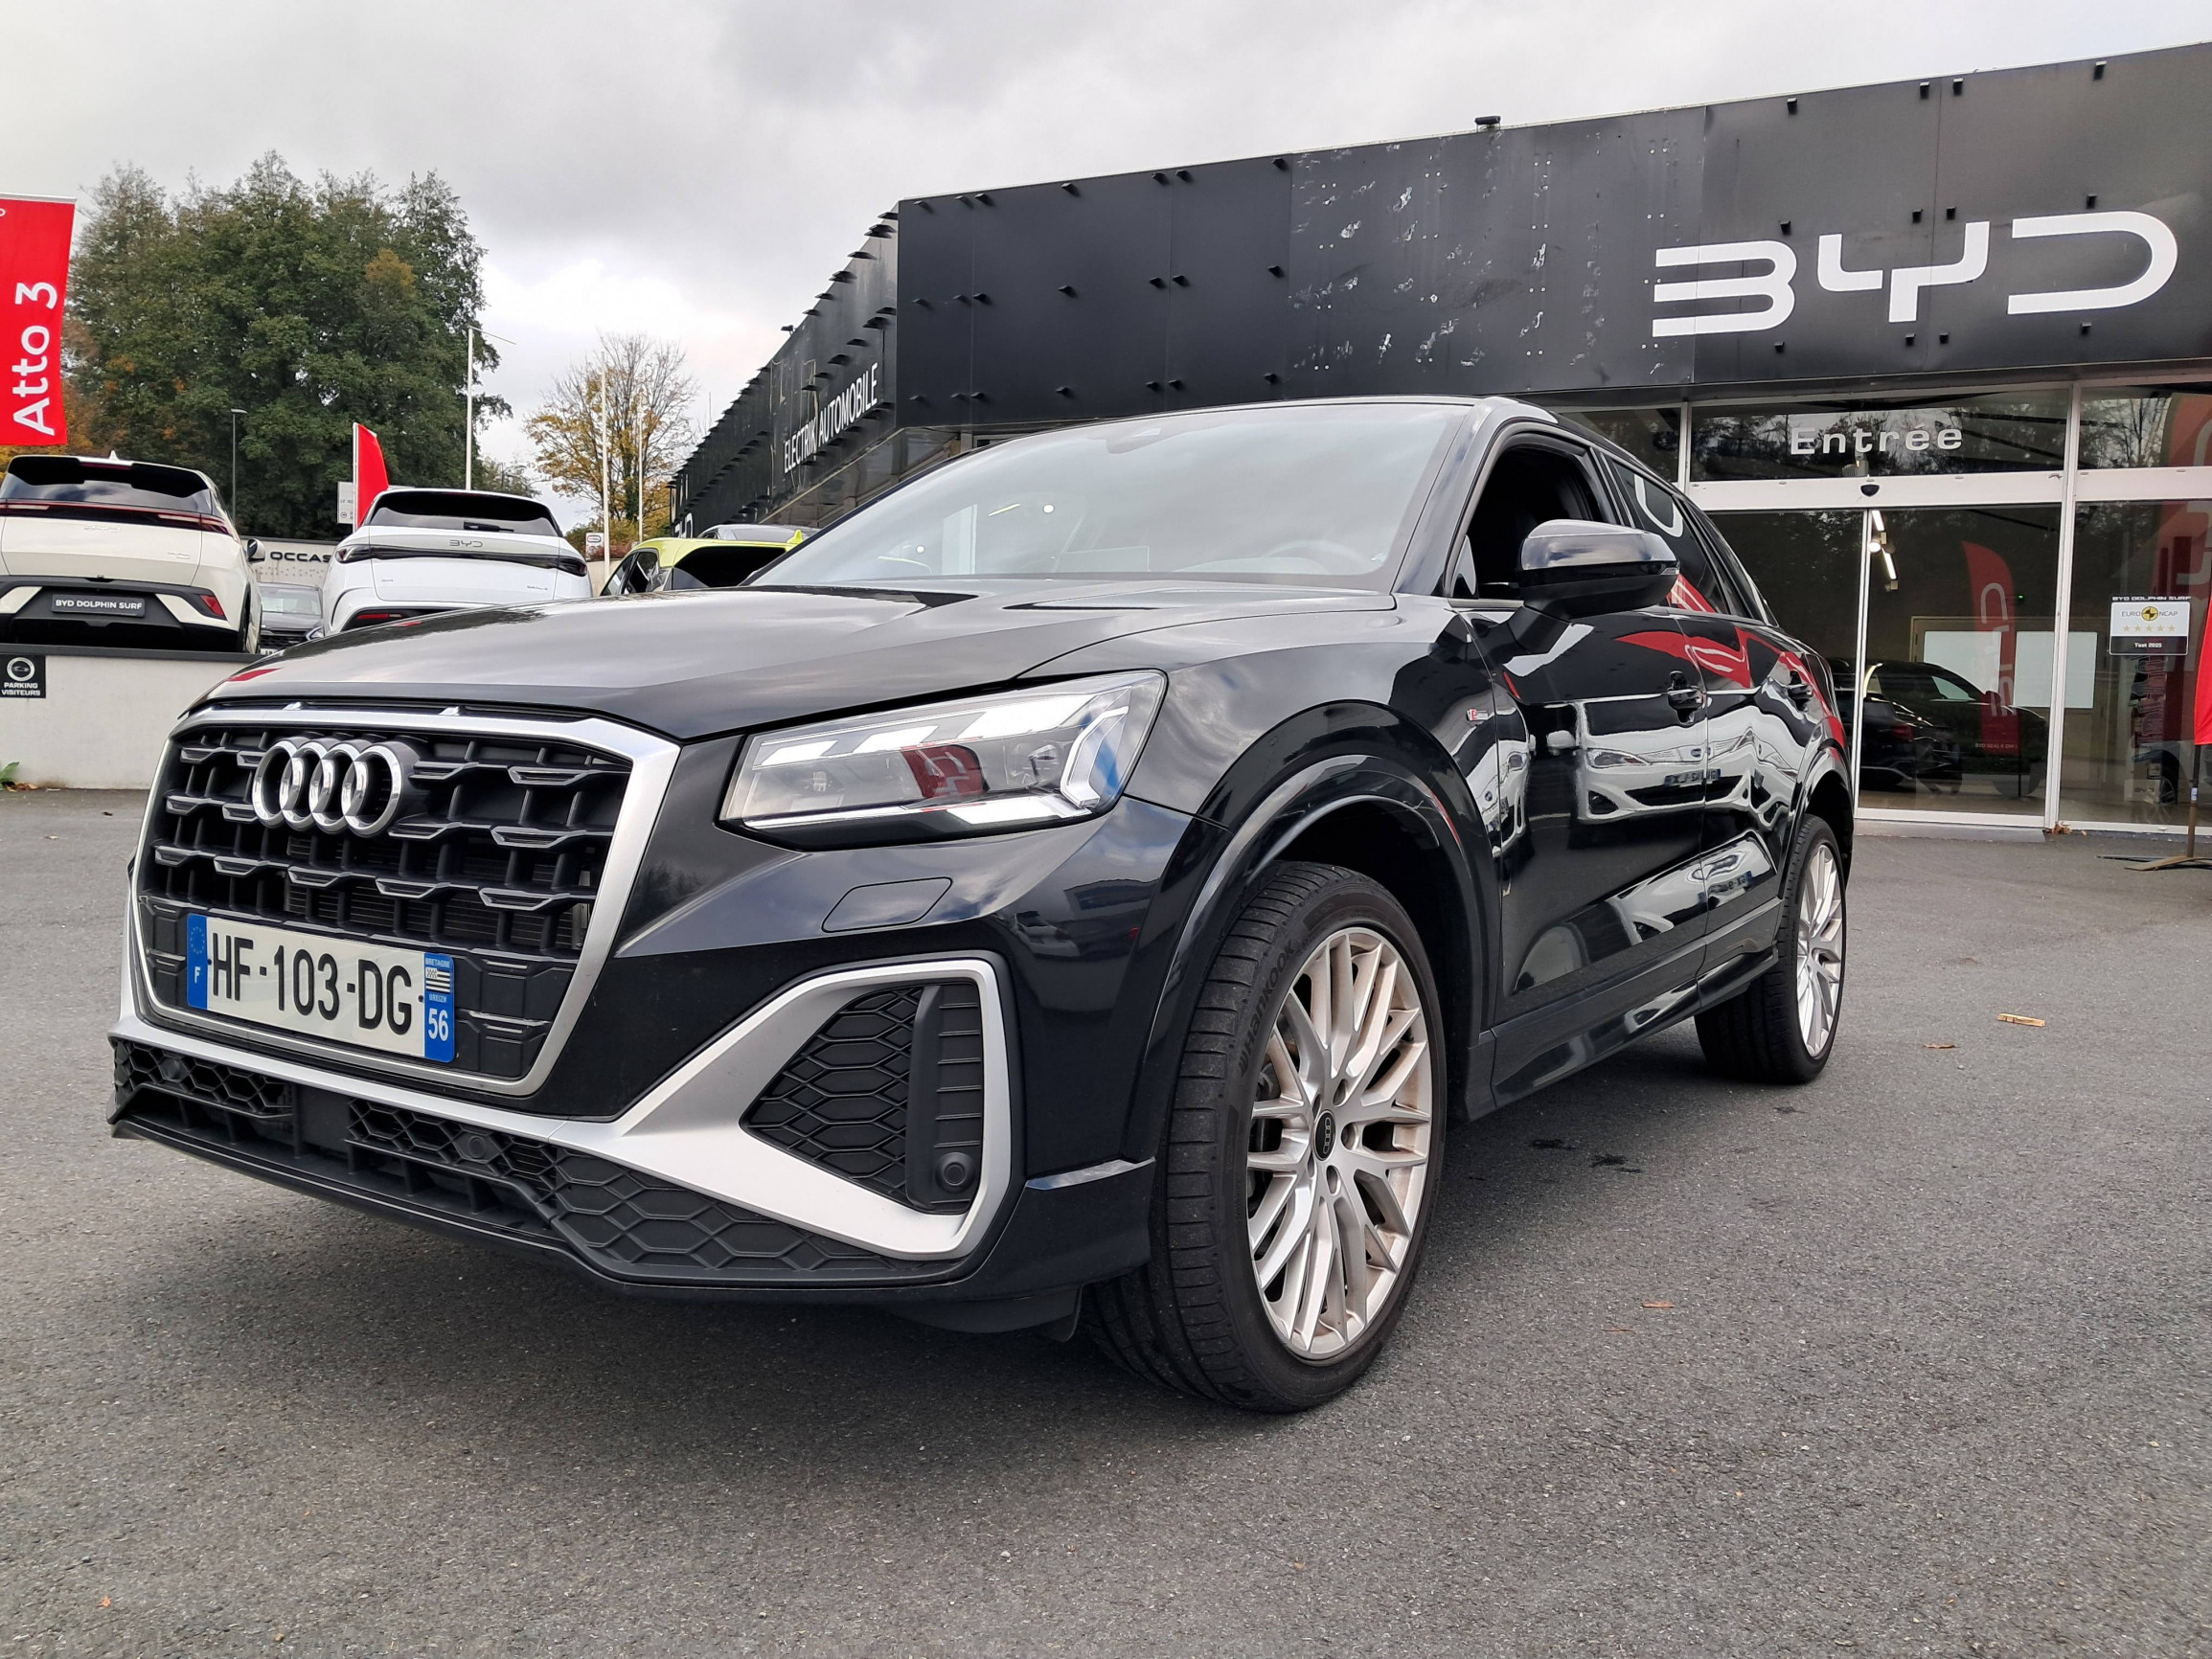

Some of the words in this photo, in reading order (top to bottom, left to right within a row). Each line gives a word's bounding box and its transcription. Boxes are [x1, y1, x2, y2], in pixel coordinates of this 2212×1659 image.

[1653, 211, 2178, 337] BYD
[14, 282, 58, 309] 3
[11, 325, 56, 436] Atto
[783, 416, 817, 473] ELECTRIK
[818, 362, 878, 448] AUTOMOBILE
[1790, 421, 1965, 456] Entrée
[449, 538, 484, 549] BYD
[55, 599, 75, 608] BYD
[76, 600, 117, 610] DOLPHIN
[118, 602, 143, 611] SURF
[1, 689, 41, 697] VISITEURS
[4, 681, 38, 690] PARKING
[425, 958, 451, 968] BRETAGNE
[194, 966, 201, 984] F
[212, 932, 413, 1035] HF-103-DG
[429, 993, 447, 1003] BREIZH
[427, 1008, 449, 1042] 56
